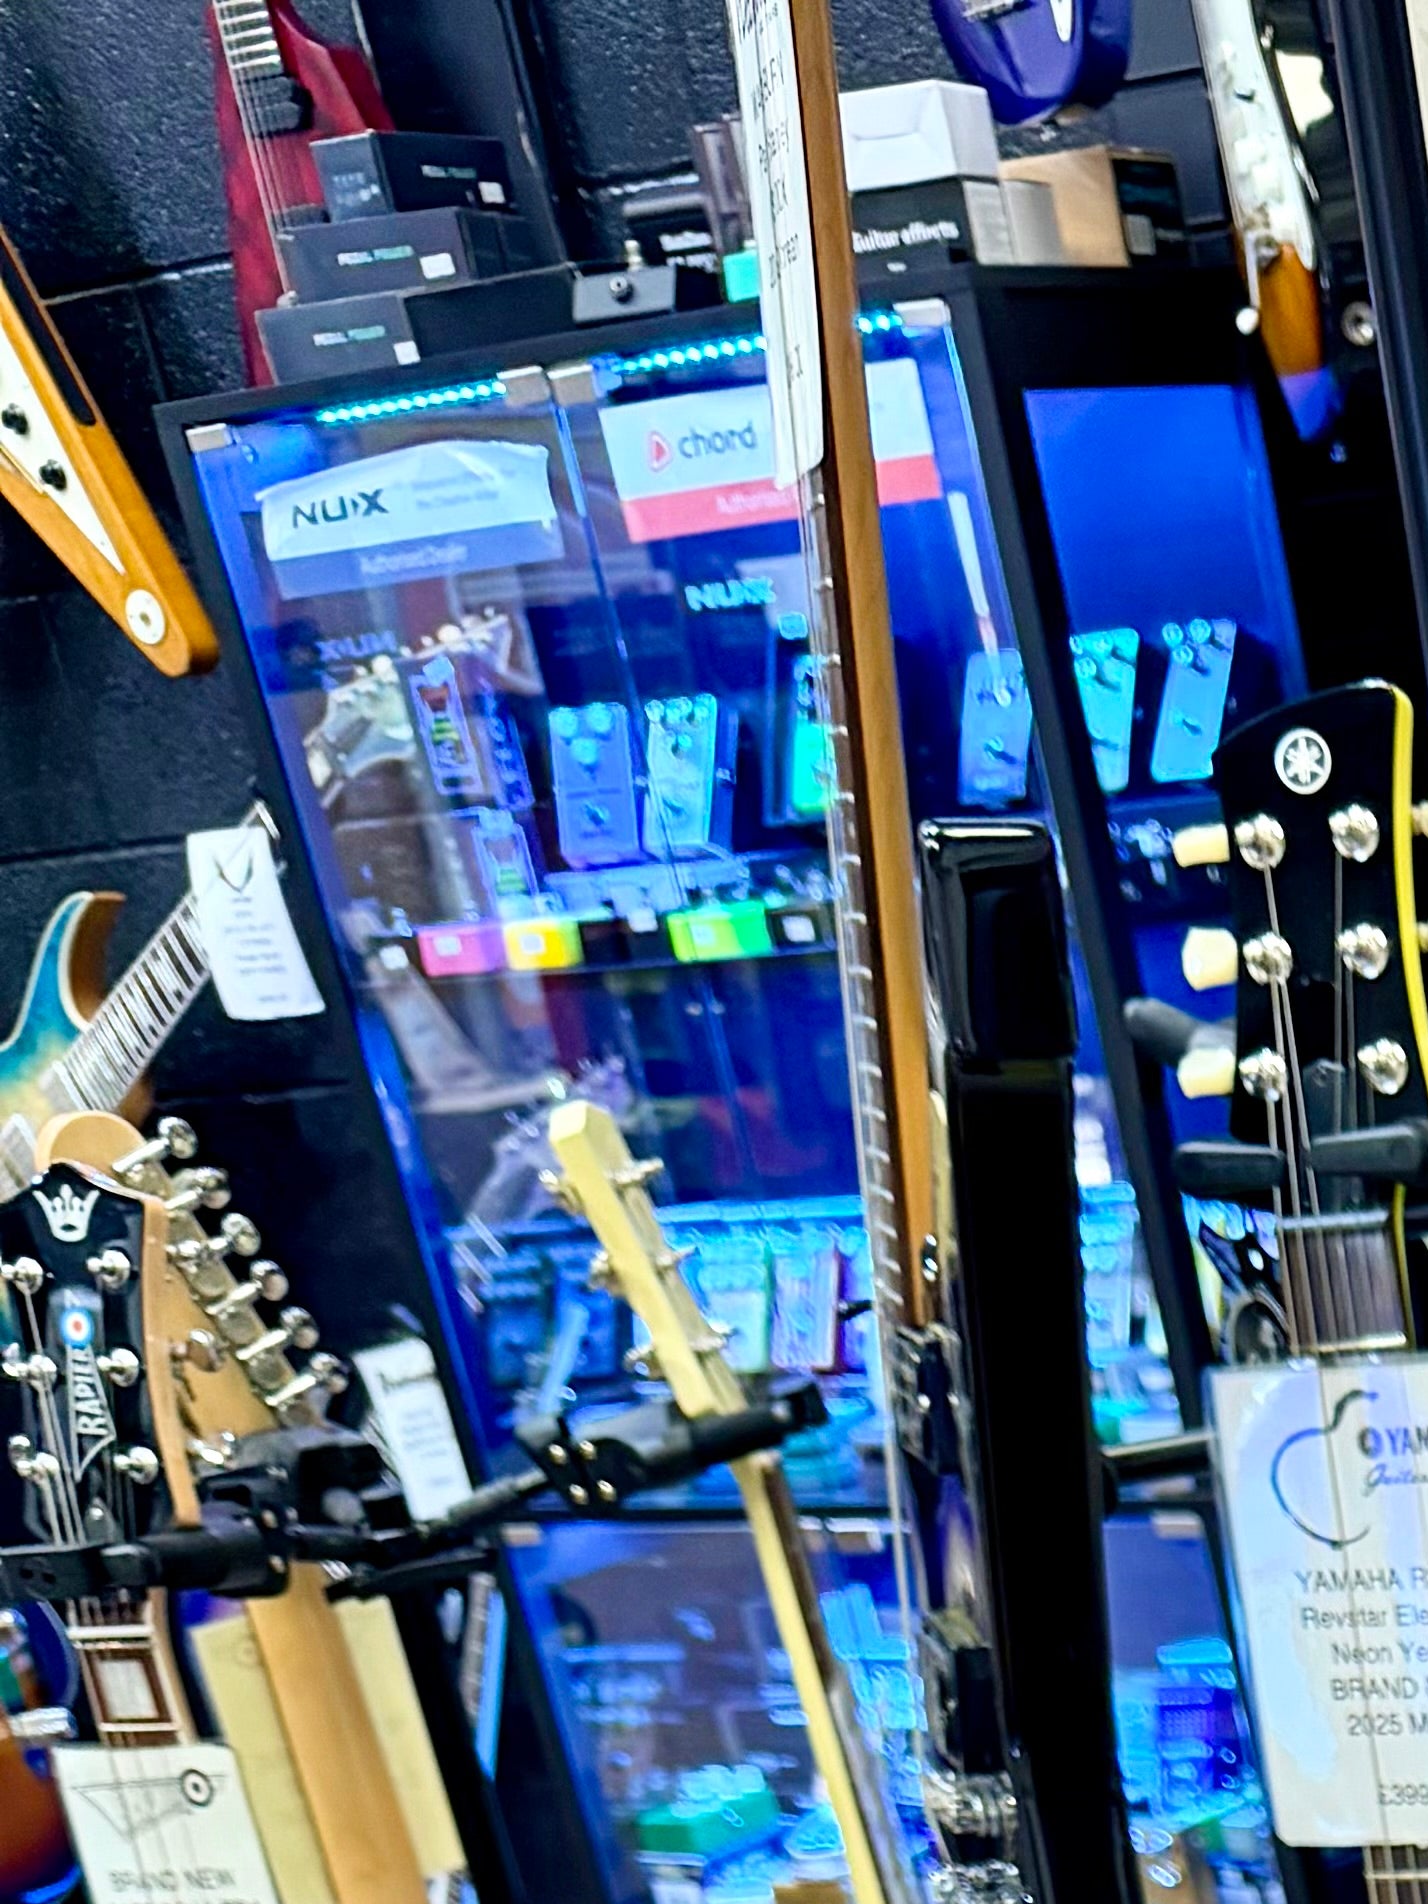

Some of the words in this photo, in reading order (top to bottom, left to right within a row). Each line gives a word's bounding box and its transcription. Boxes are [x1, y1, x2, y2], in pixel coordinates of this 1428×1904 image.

[677, 421, 758, 459] chord
[1294, 1566, 1405, 1593] YAMAHA
[1302, 1606, 1388, 1630] Revstar
[1332, 1641, 1394, 1666] Neon
[1331, 1676, 1420, 1701] BRAND
[1347, 1712, 1403, 1737] 2025
